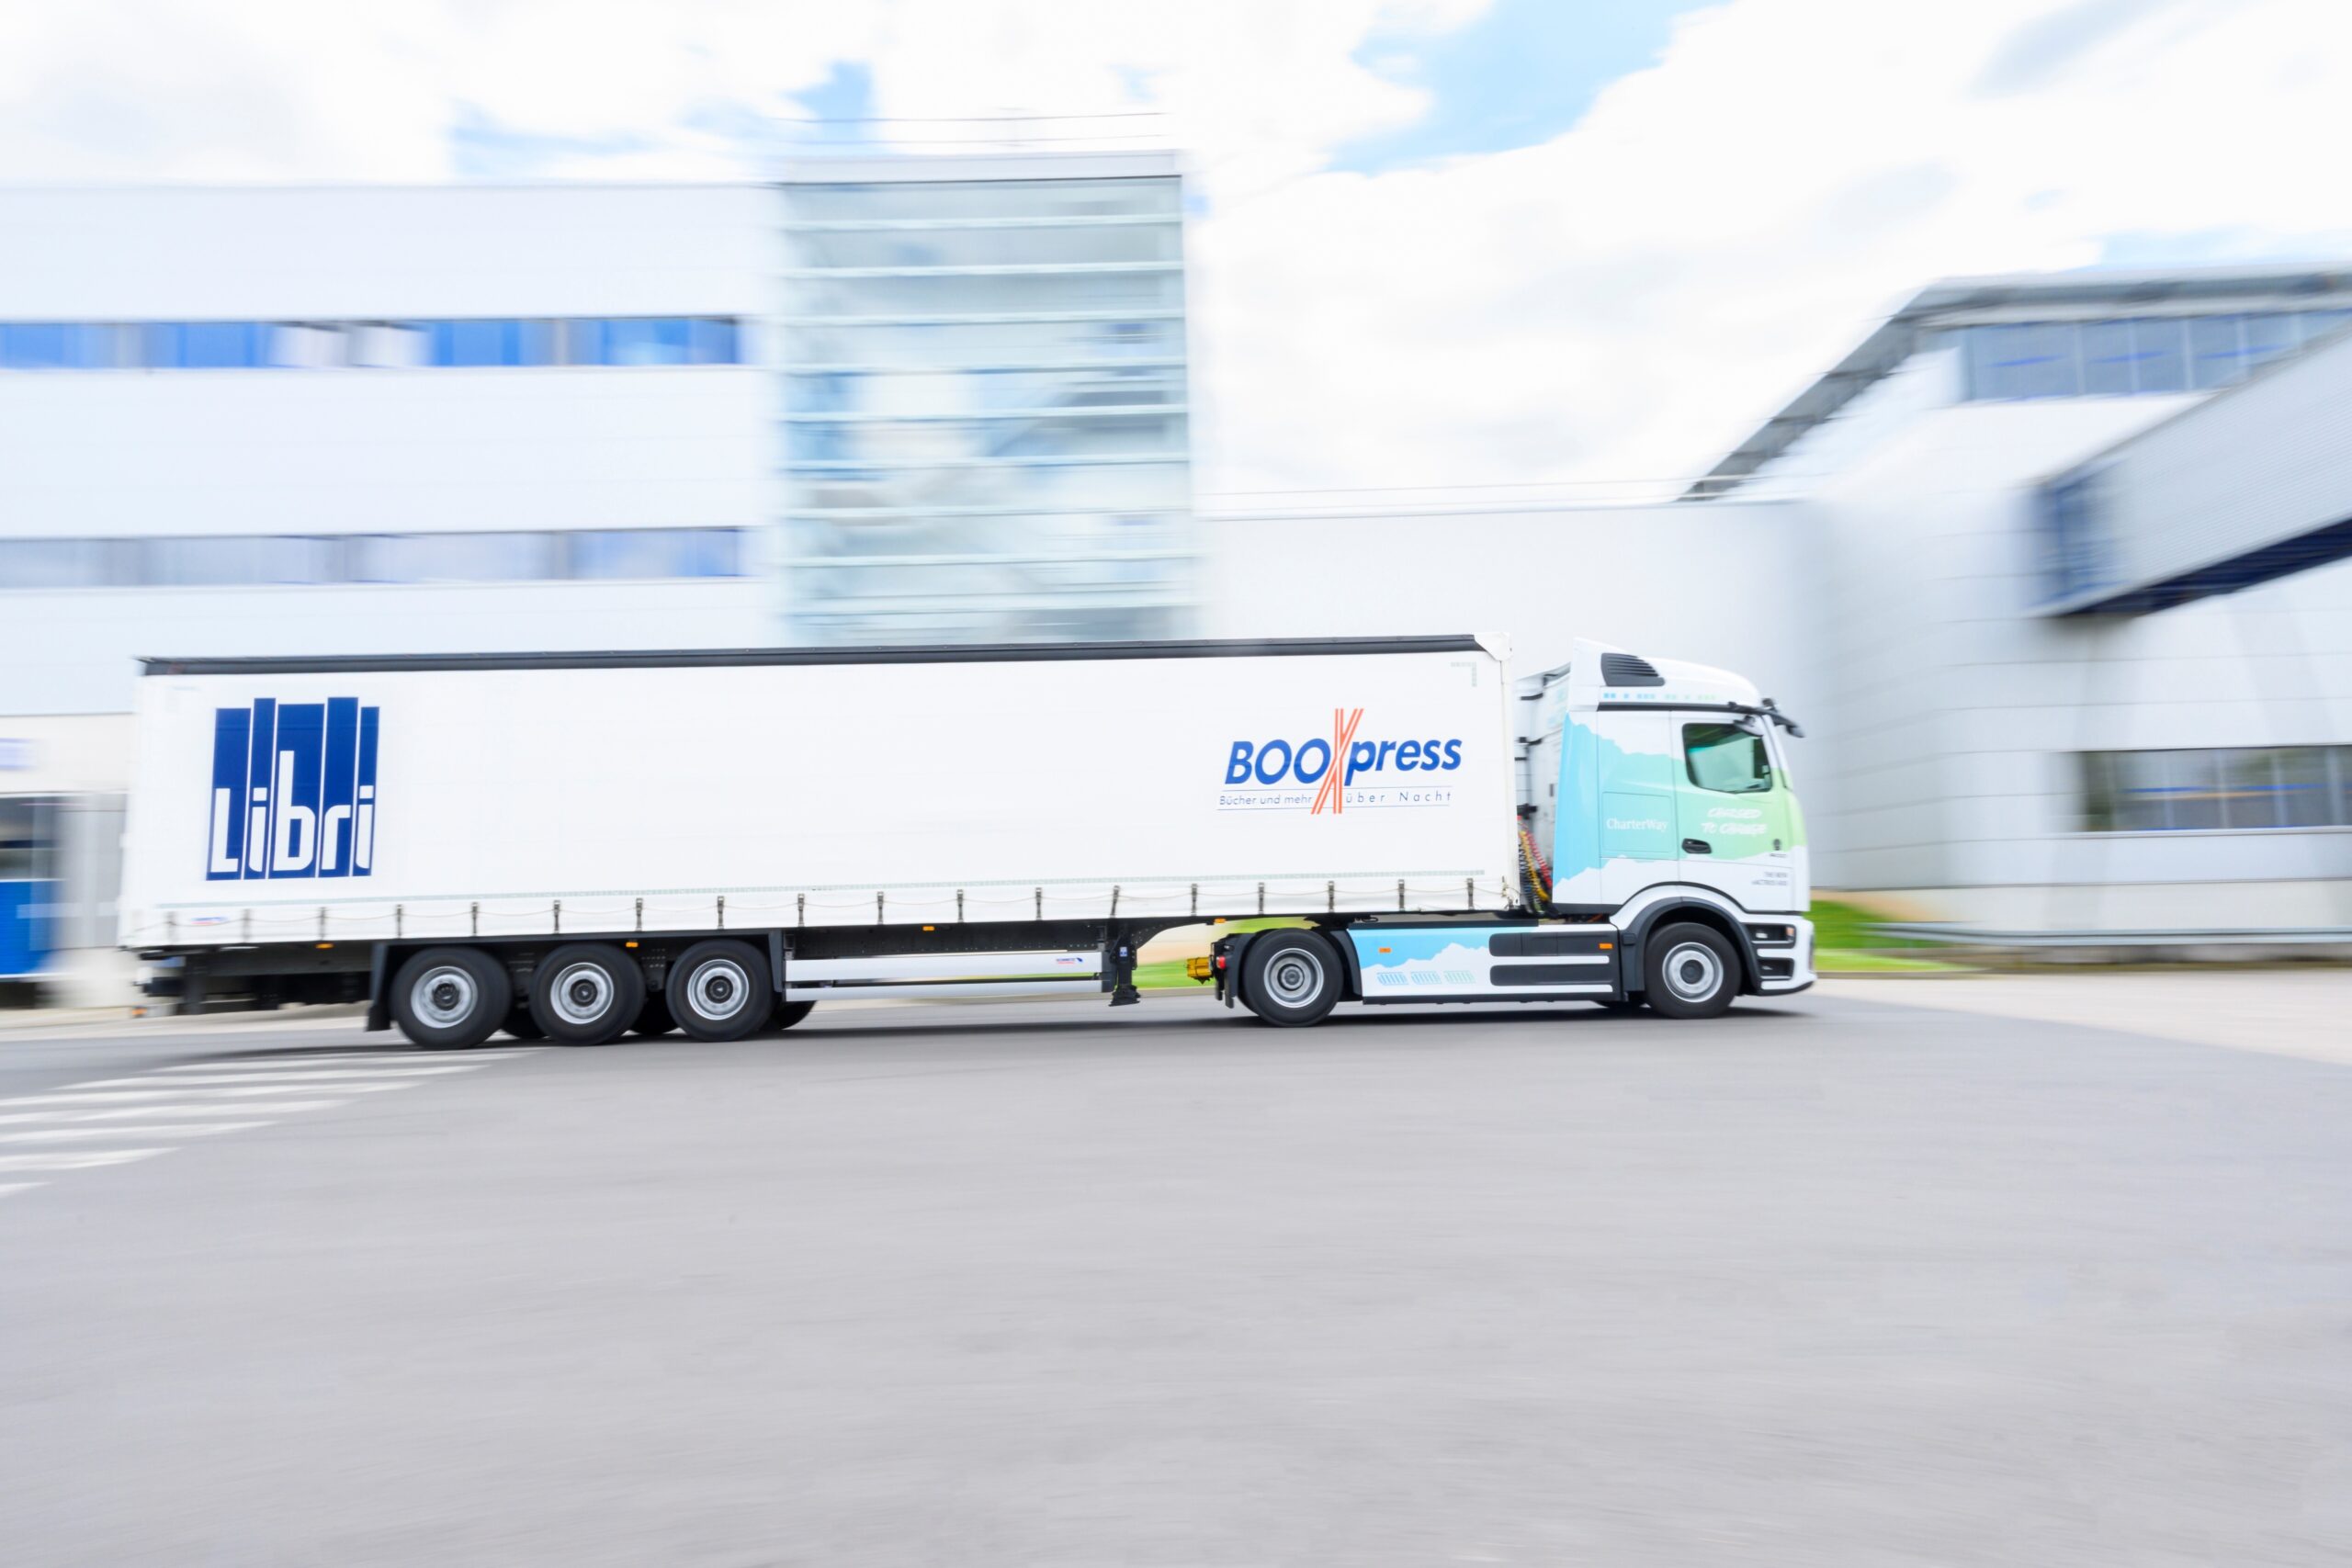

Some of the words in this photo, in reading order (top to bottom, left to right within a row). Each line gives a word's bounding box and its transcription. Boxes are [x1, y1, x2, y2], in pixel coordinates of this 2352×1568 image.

[1219, 795, 1257, 806] Bücher
[1260, 794, 1281, 805] und
[1283, 794, 1312, 804] mehr
[1346, 792, 1385, 803] über
[1399, 790, 1451, 802] Nacht
[209, 750, 375, 873] Libri
[1606, 818, 1668, 832] CharterWay
